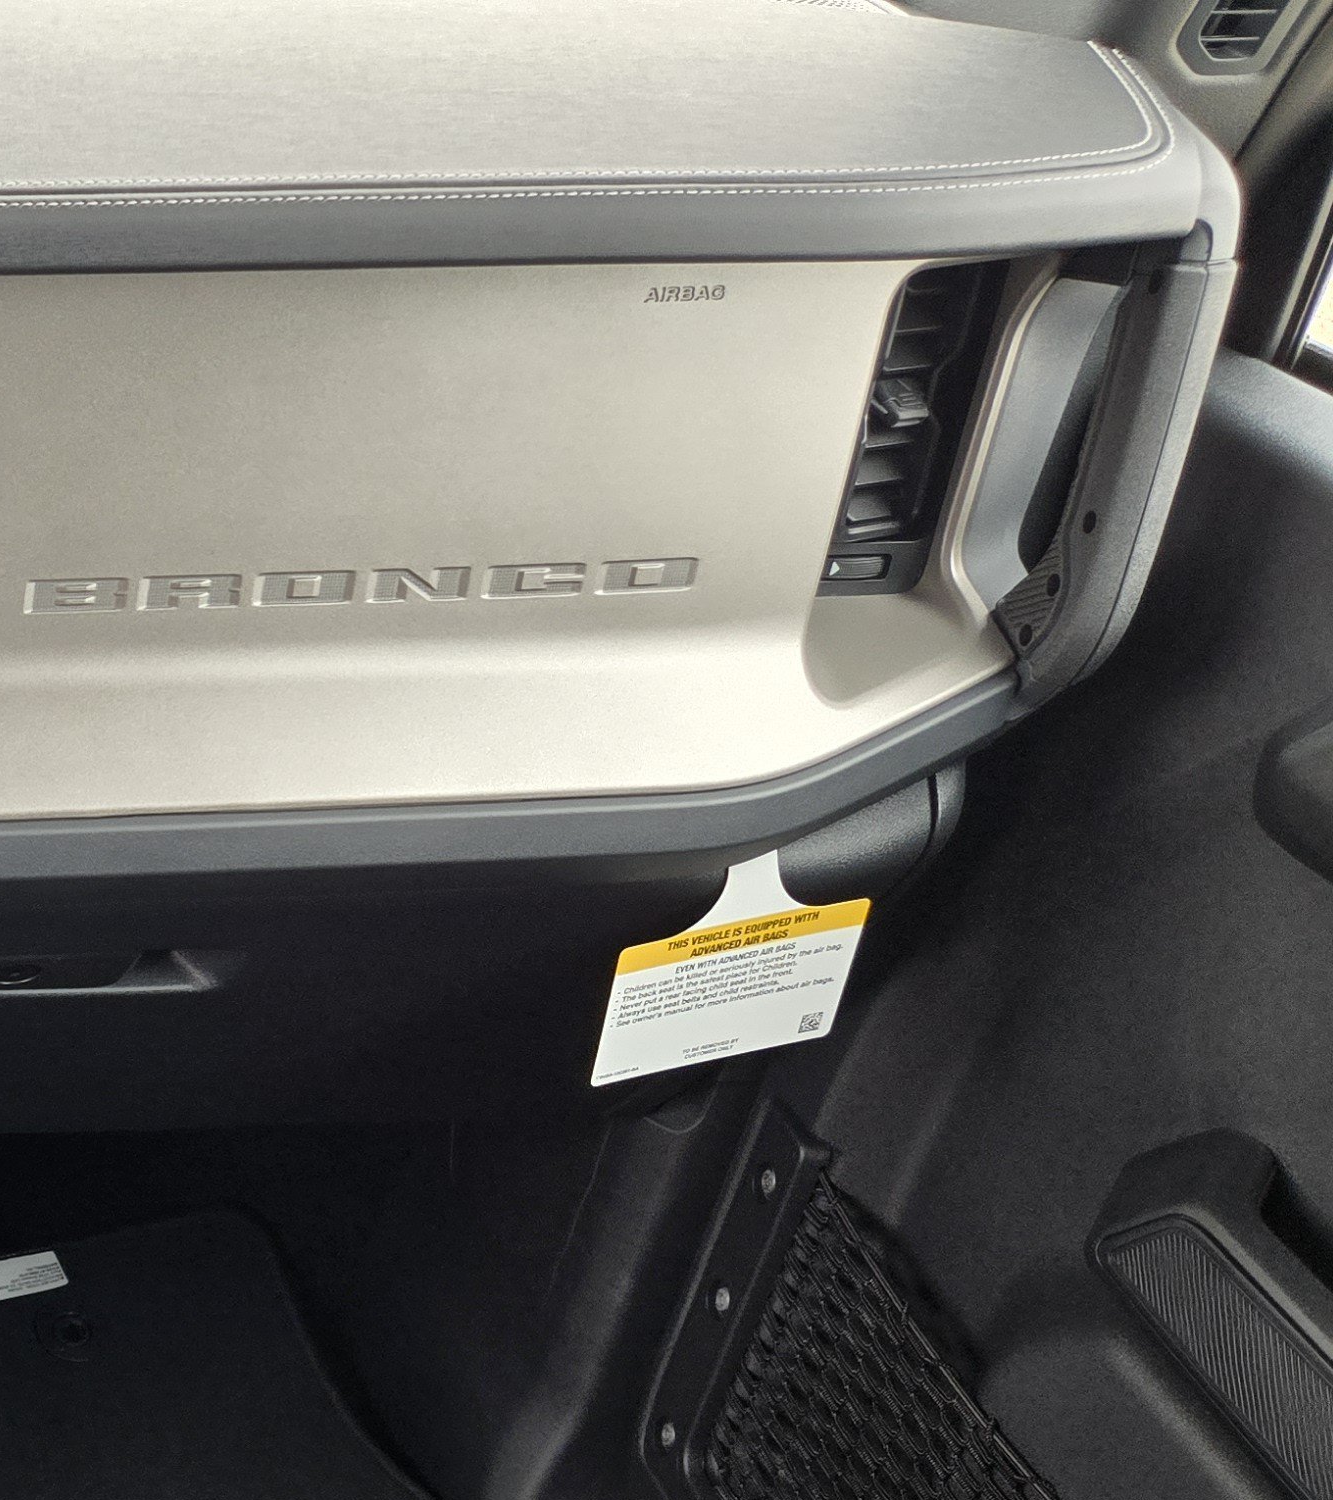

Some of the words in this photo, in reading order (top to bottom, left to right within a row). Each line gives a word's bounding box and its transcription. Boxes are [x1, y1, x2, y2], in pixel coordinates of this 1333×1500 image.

[643, 284, 726, 303] AIRBAG
[23, 557, 699, 614] BRONCO
[667, 938, 689, 951] THIS
[692, 929, 731, 945] VEHICLE
[733, 927, 742, 937] IS
[745, 917, 791, 934] EQUIPPED
[794, 911, 820, 924] WITH
[690, 939, 741, 957] ADVANCED
[743, 935, 759, 946] AIR
[763, 930, 788, 942] BAGS
[675, 964, 694, 974] EVEN
[697, 958, 716, 969] WITH
[719, 951, 759, 964] ADVANCED
[760, 947, 773, 956] AIR
[622, 994, 636, 1002] The
[624, 982, 656, 994] Children
